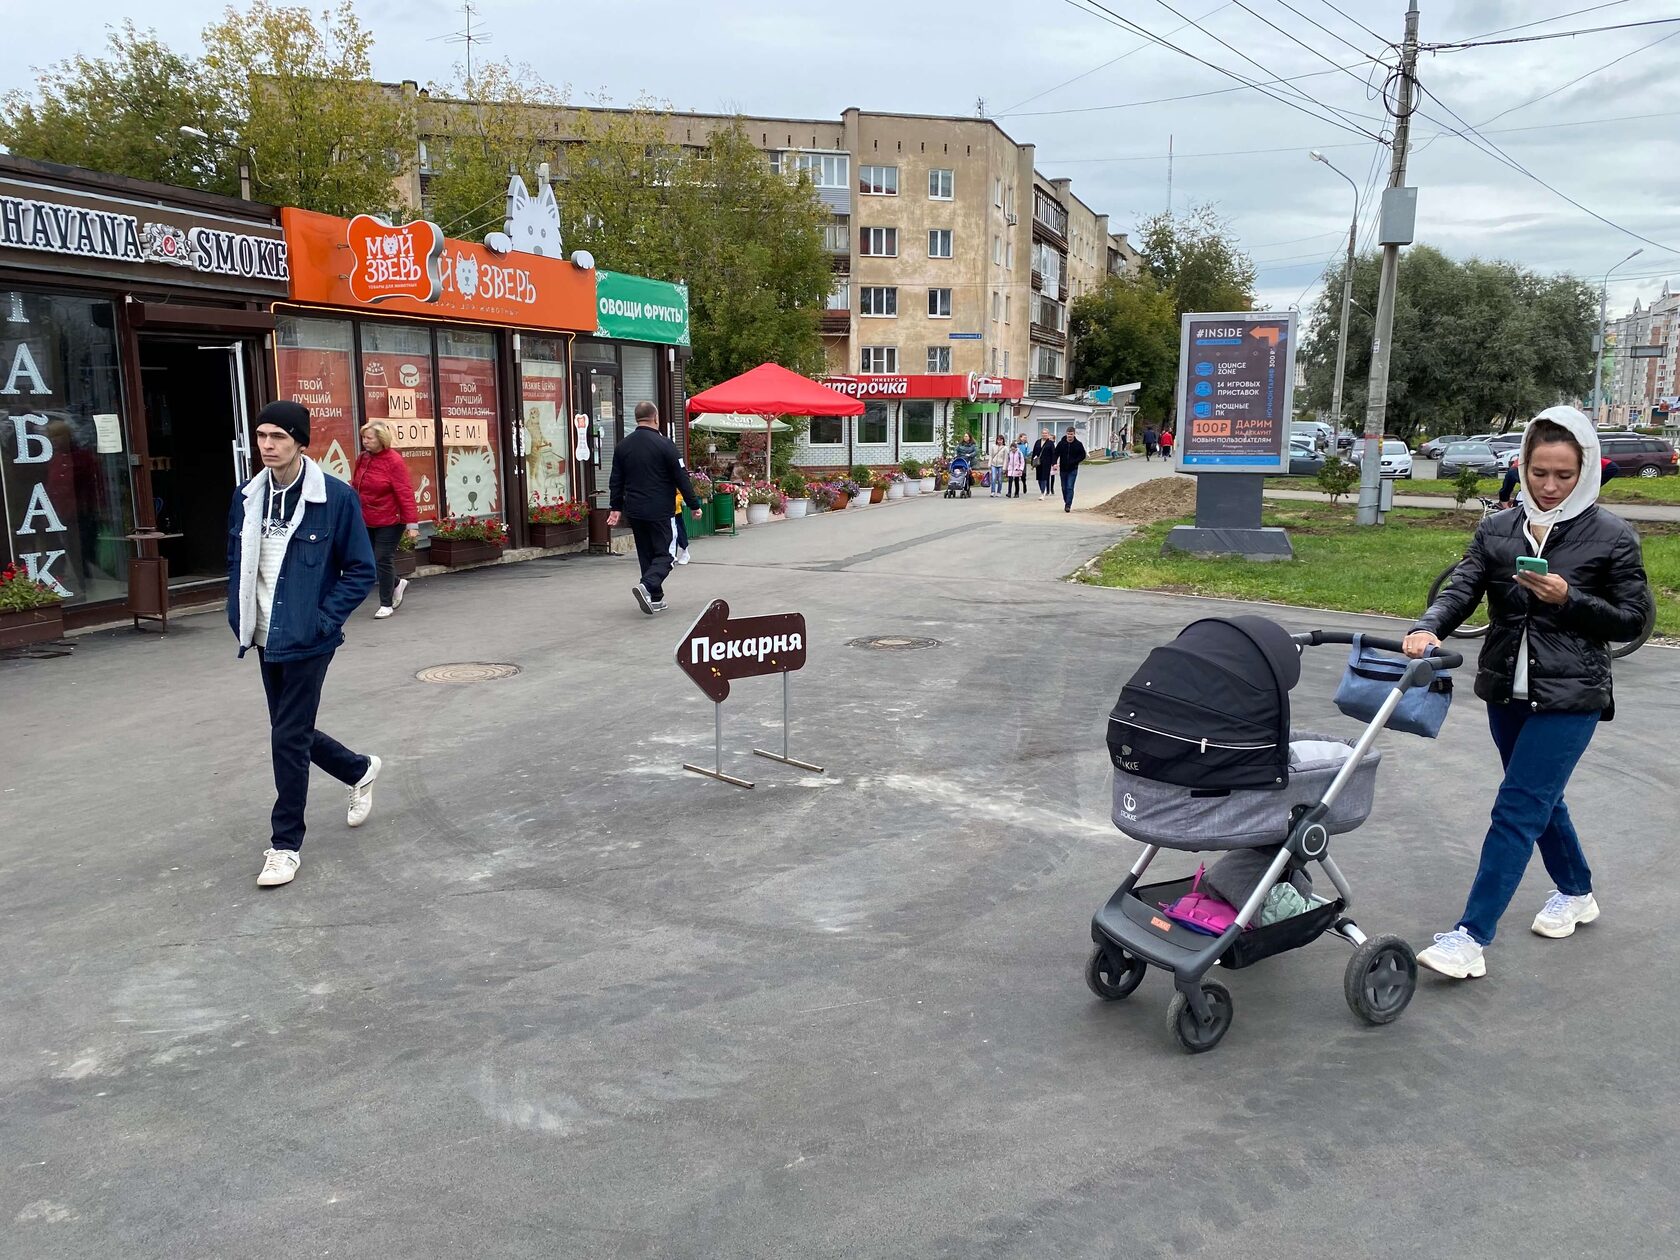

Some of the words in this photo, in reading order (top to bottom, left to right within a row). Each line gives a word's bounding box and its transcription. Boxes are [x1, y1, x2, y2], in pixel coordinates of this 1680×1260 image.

[0, 199, 144, 259] HAVANA
[196, 230, 289, 279] SMOKE
[365, 255, 421, 284] ЗВЕРЬ
[480, 264, 536, 304] ЗВЕРЬ
[600, 297, 642, 320] ОВОЩИ
[643, 304, 684, 324] ФРУКТЫ
[1196, 328, 1243, 338] #INSIDE
[298, 377, 323, 390] ТВОЙ
[459, 382, 477, 393] ТВОЙ
[292, 391, 332, 404] ЛУЧШИЙ
[389, 395, 413, 410] МЫ
[454, 394, 483, 405] ЛУЧШИЙ
[307, 407, 343, 417] АГАЗИН
[447, 407, 490, 416] ЗООМАГАЗИН
[1235, 420, 1273, 429] ДАРИМ
[386, 425, 481, 440] БОТАЕМ!
[691, 633, 802, 664] Пекарня
